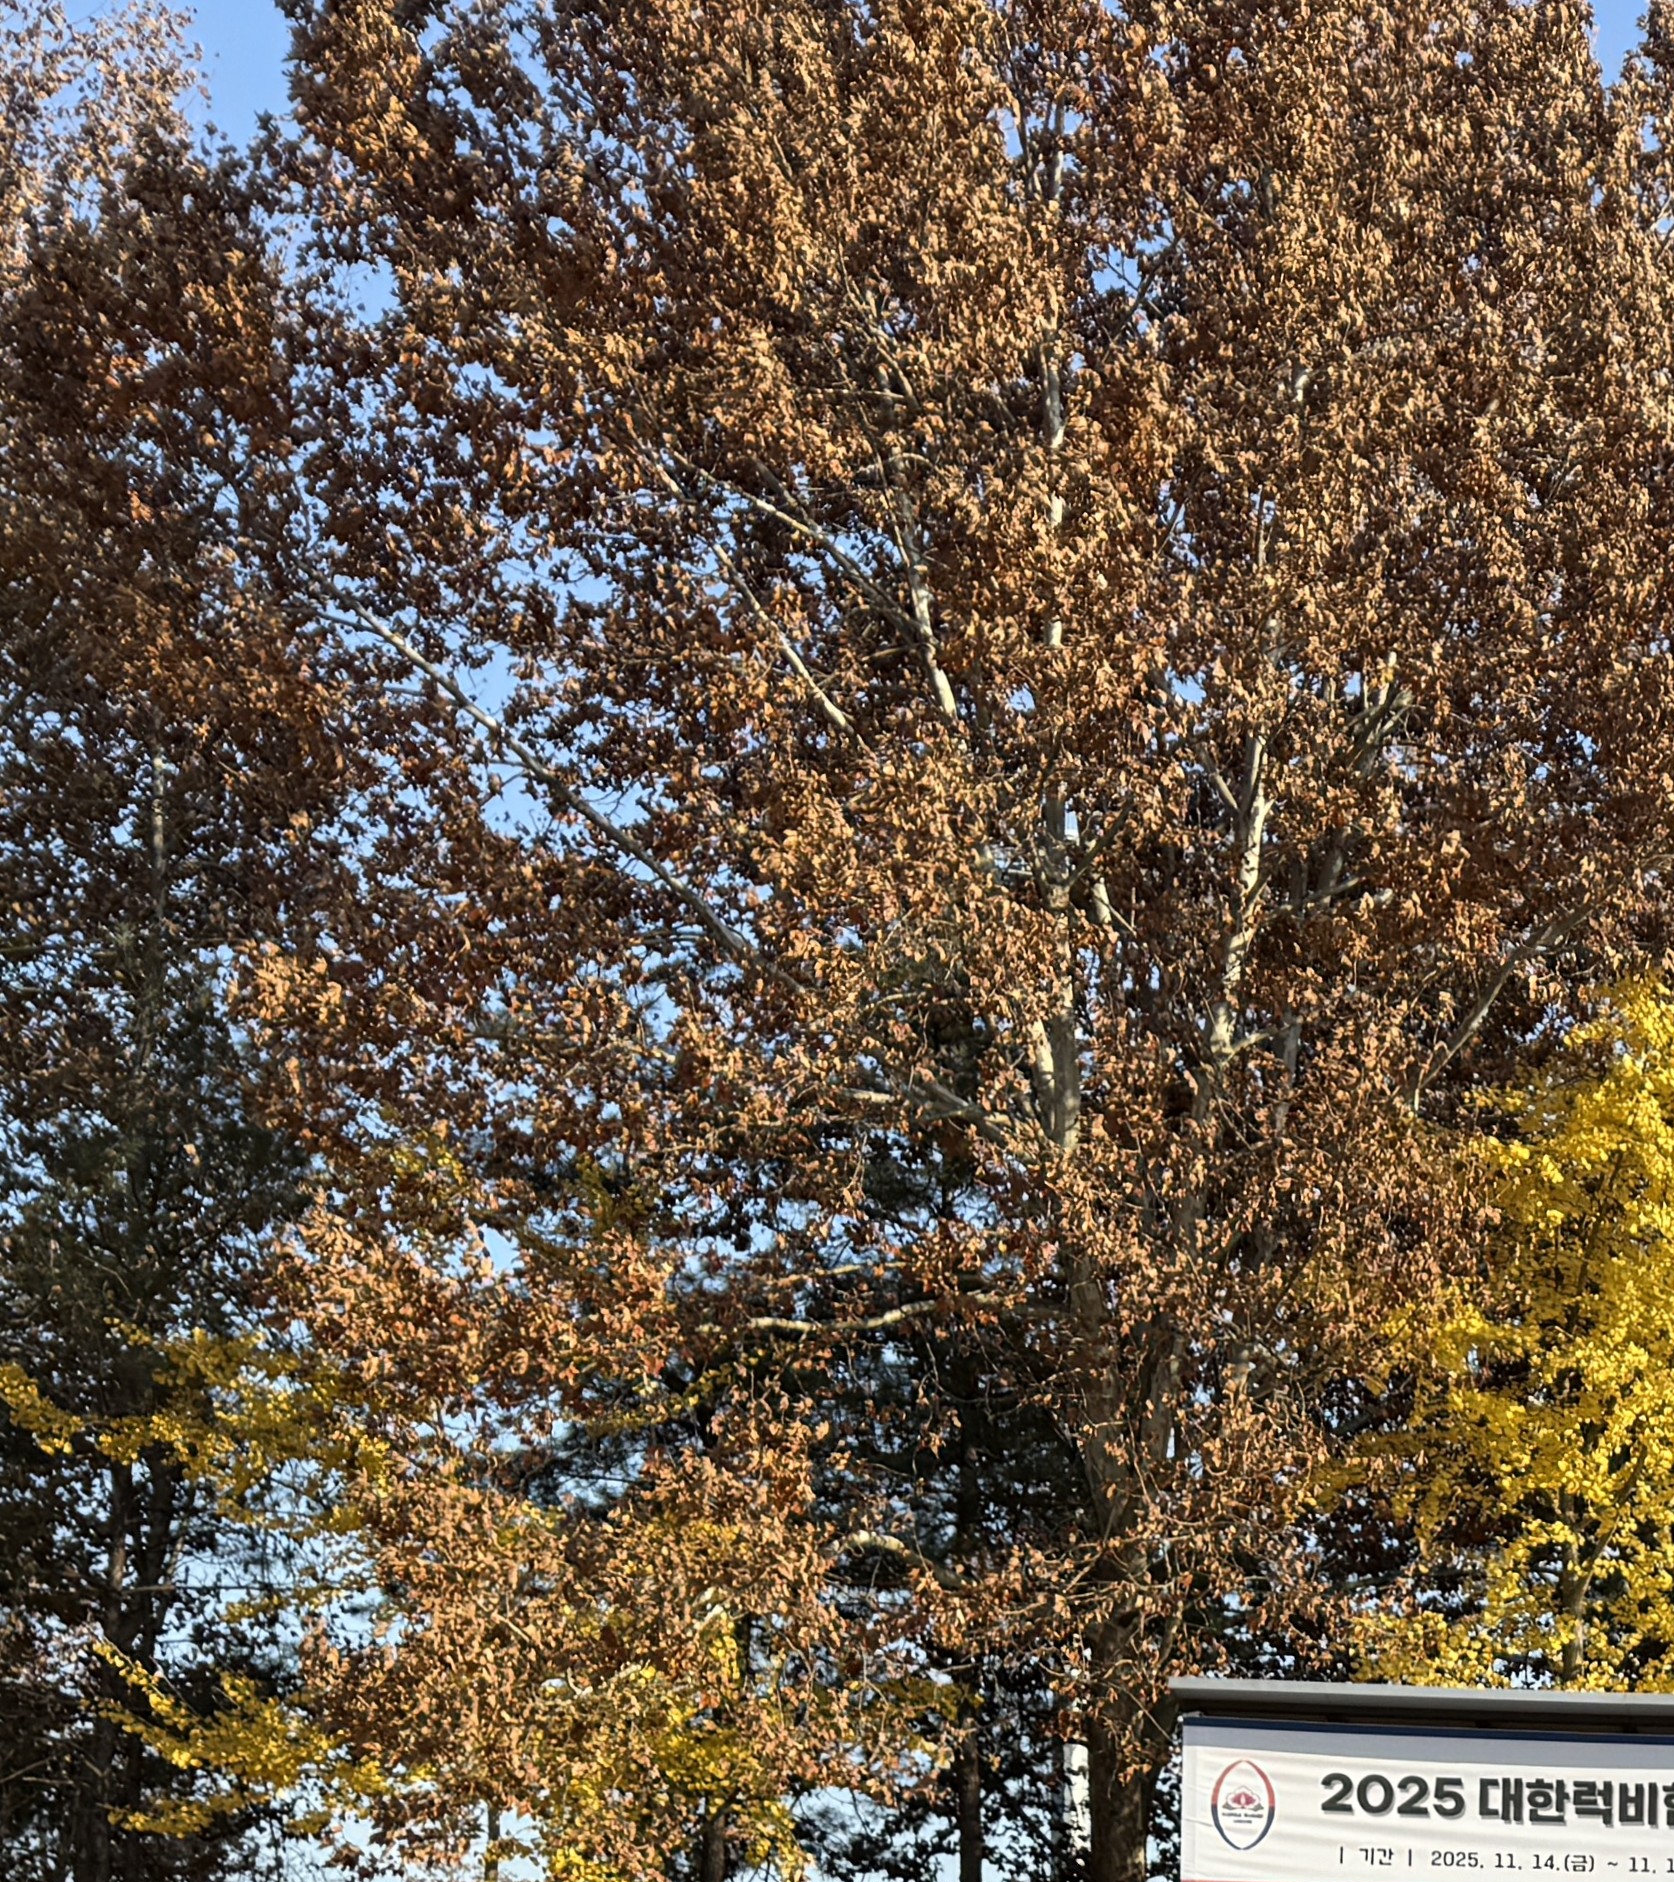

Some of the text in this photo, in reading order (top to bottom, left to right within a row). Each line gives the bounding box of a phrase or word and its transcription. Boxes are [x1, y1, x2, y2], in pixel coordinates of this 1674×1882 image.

[1320, 1772, 1466, 1819] 2025
[1358, 1847, 1394, 1866] 기간
[1431, 1850, 1484, 1869] 2025.
[1494, 1853, 1522, 1870] 11.
[1628, 1857, 1657, 1874] 11.
